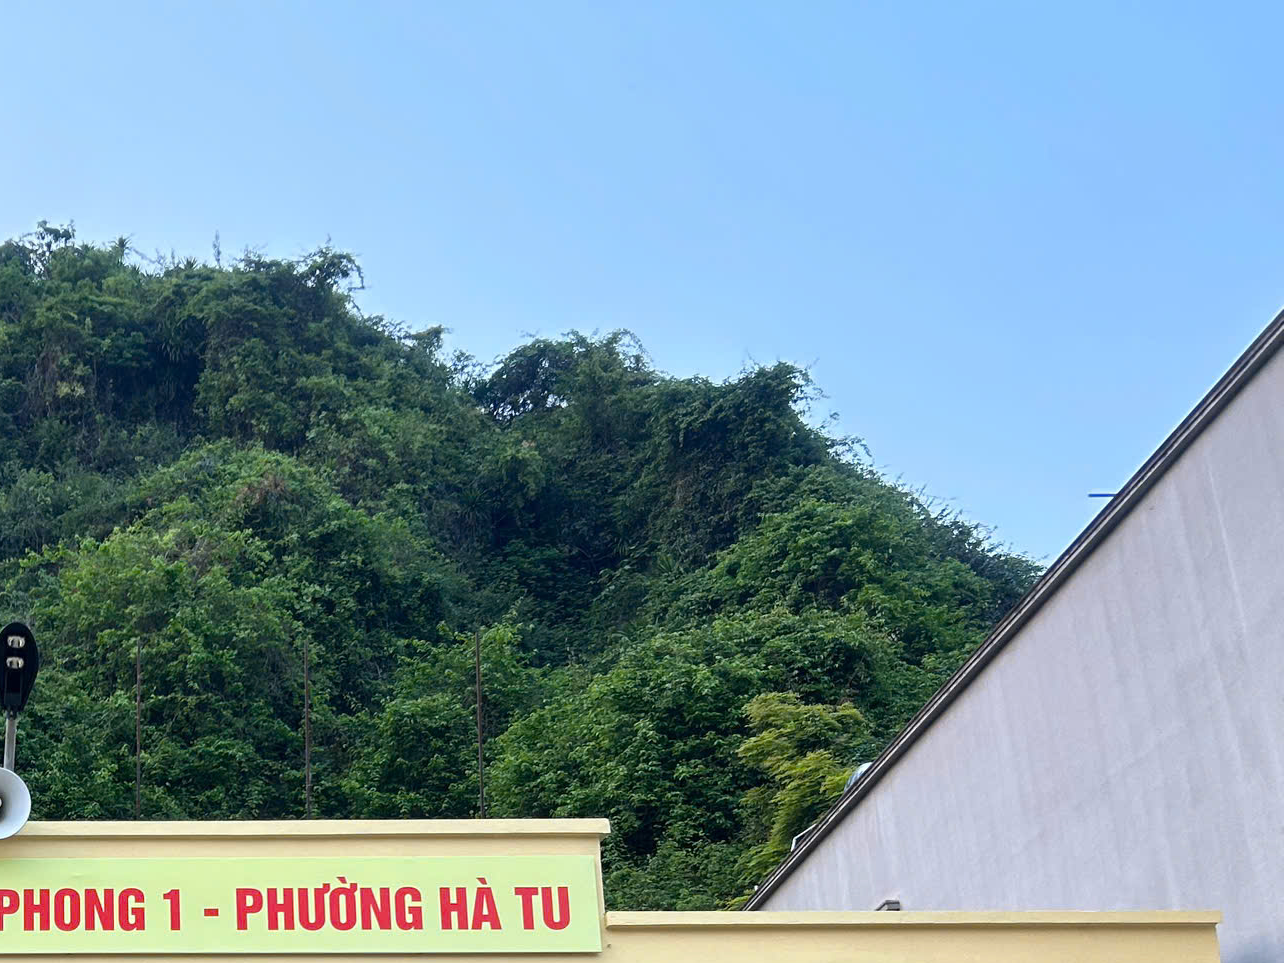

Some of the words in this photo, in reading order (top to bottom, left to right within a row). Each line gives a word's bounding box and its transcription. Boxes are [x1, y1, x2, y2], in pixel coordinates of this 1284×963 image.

[164, 888, 180, 931] 1
[203, 907, 220, 917] -
[235, 876, 424, 931] PHƯỜNG
[440, 877, 502, 931] HÀ
[514, 886, 571, 931] TU
